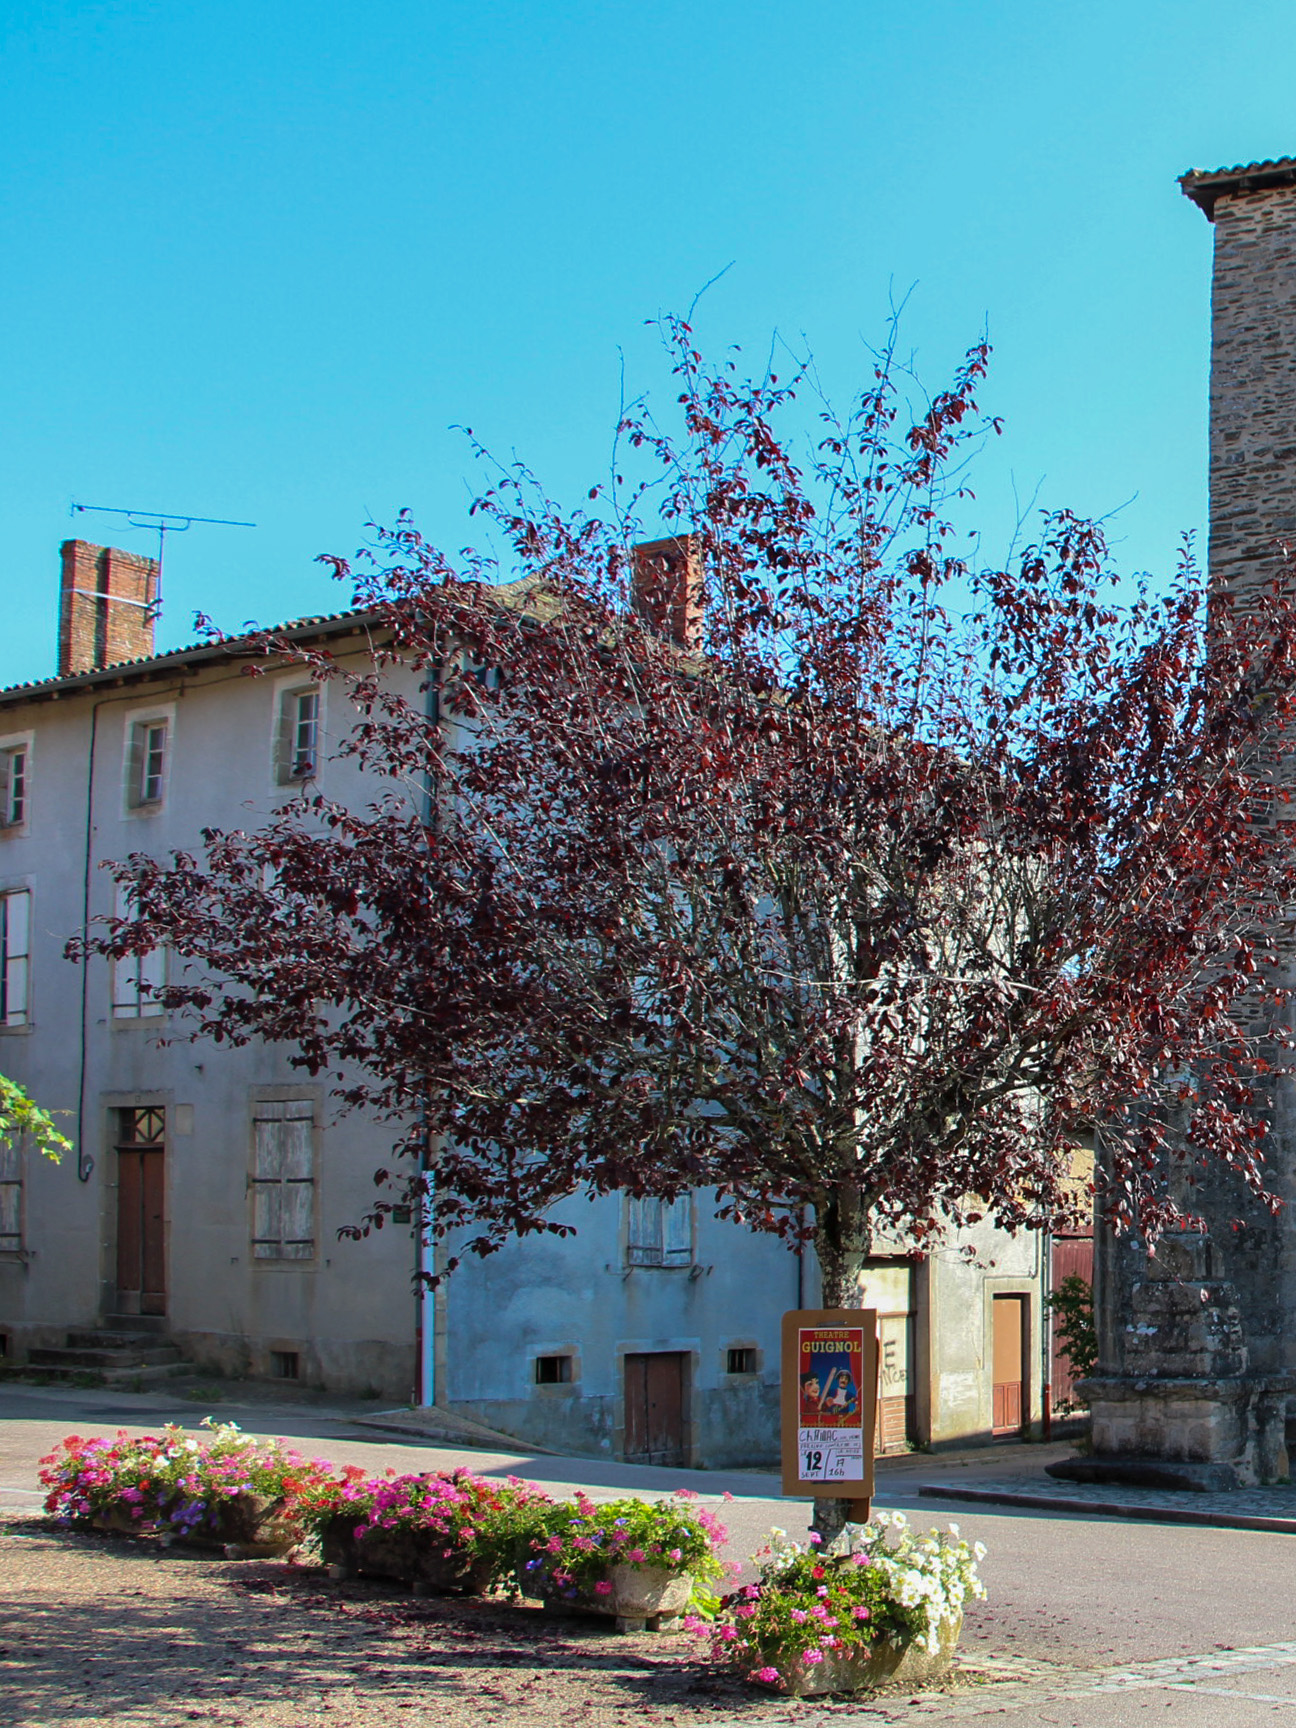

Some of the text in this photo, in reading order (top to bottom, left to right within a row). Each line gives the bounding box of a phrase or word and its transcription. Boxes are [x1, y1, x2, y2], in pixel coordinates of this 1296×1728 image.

[814, 1331, 850, 1339] THEATRE
[802, 1341, 861, 1353] GUIGNOL
[805, 1451, 822, 1471] 12
[801, 1471, 820, 1479] SEPT
